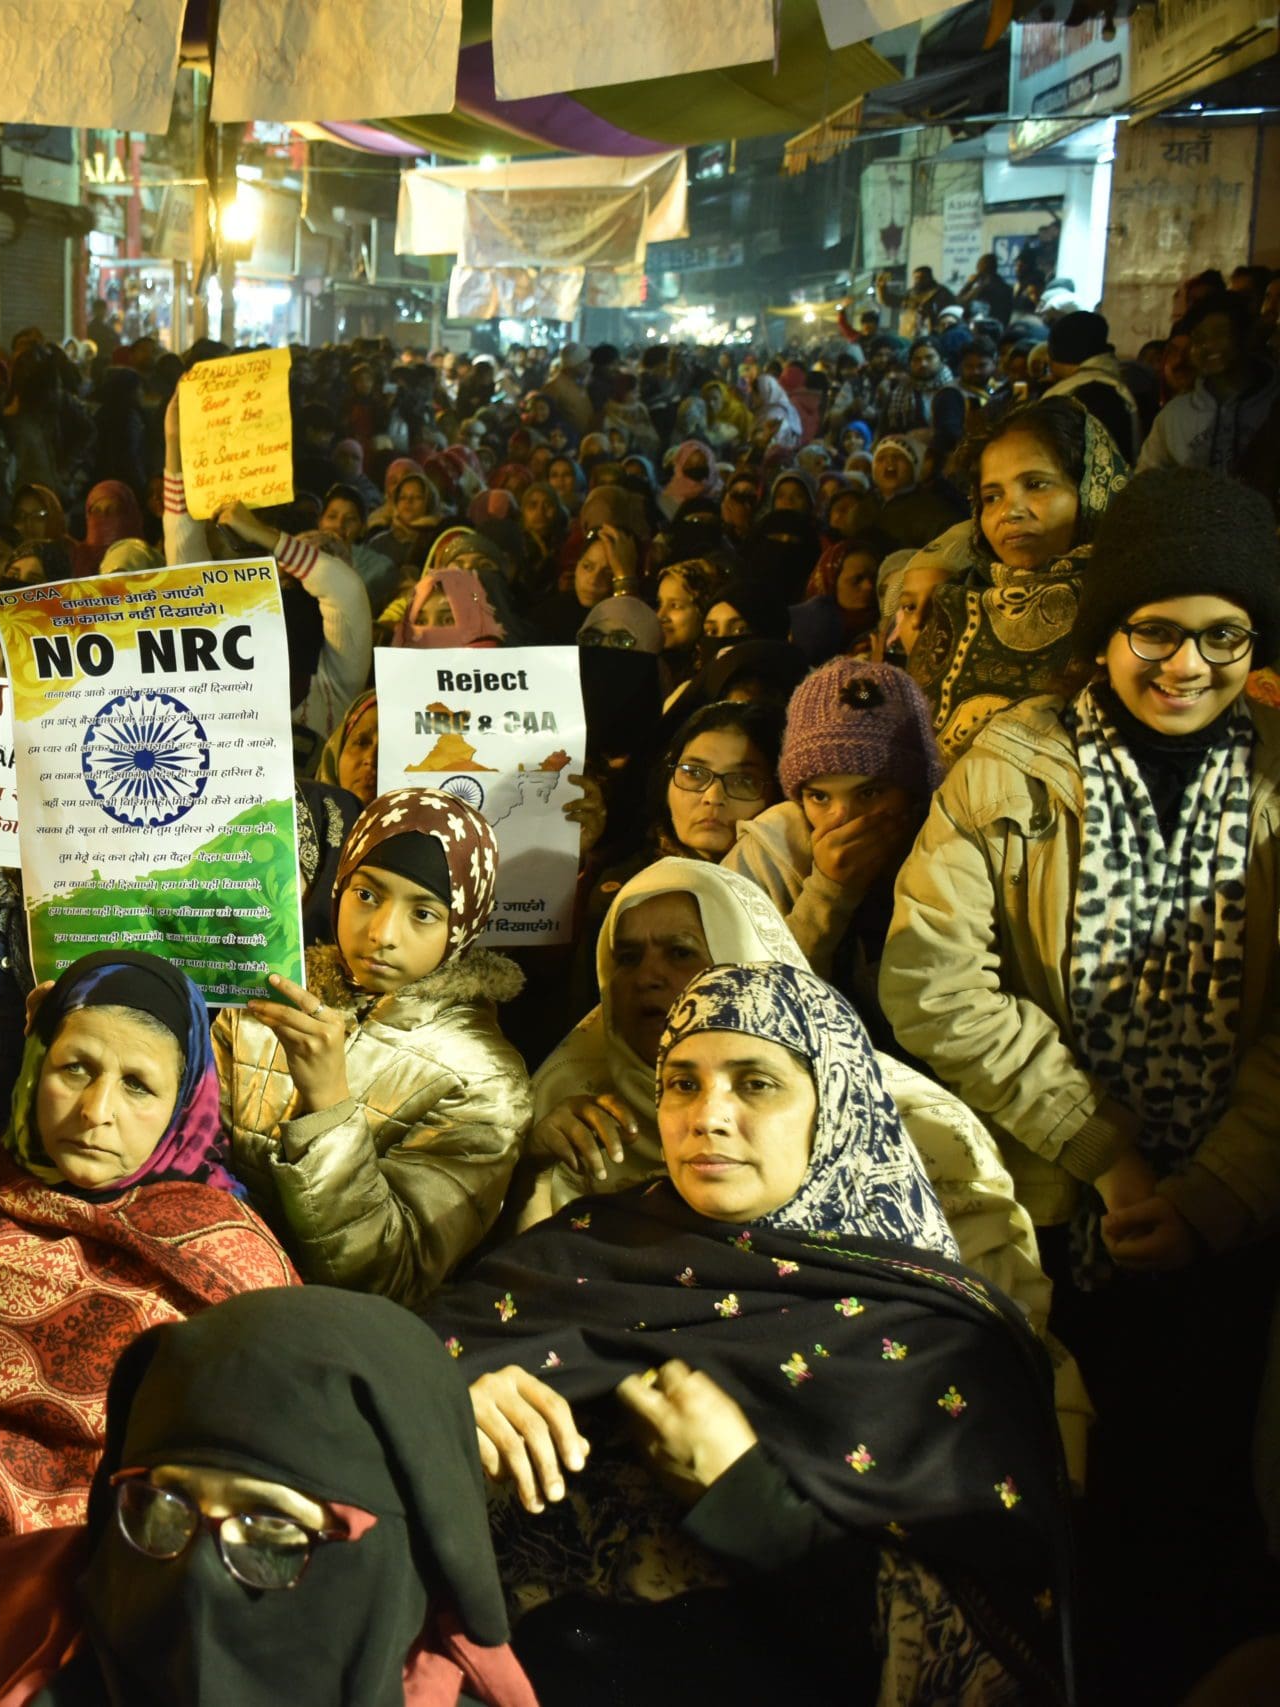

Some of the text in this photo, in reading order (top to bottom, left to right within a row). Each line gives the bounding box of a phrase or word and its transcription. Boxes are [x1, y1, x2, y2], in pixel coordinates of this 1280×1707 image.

[202, 566, 272, 585] NO NPR
[22, 587, 61, 602] CAA
[61, 584, 204, 610] तानाशाह आके जाएंगे
[52, 615, 75, 627] हम
[79, 612, 124, 625] कागज
[128, 606, 157, 622] नहीं
[33, 625, 255, 680] NO NRC
[436, 669, 529, 694] Reject
[414, 710, 471, 735] NRC
[503, 711, 558, 735] CAA
